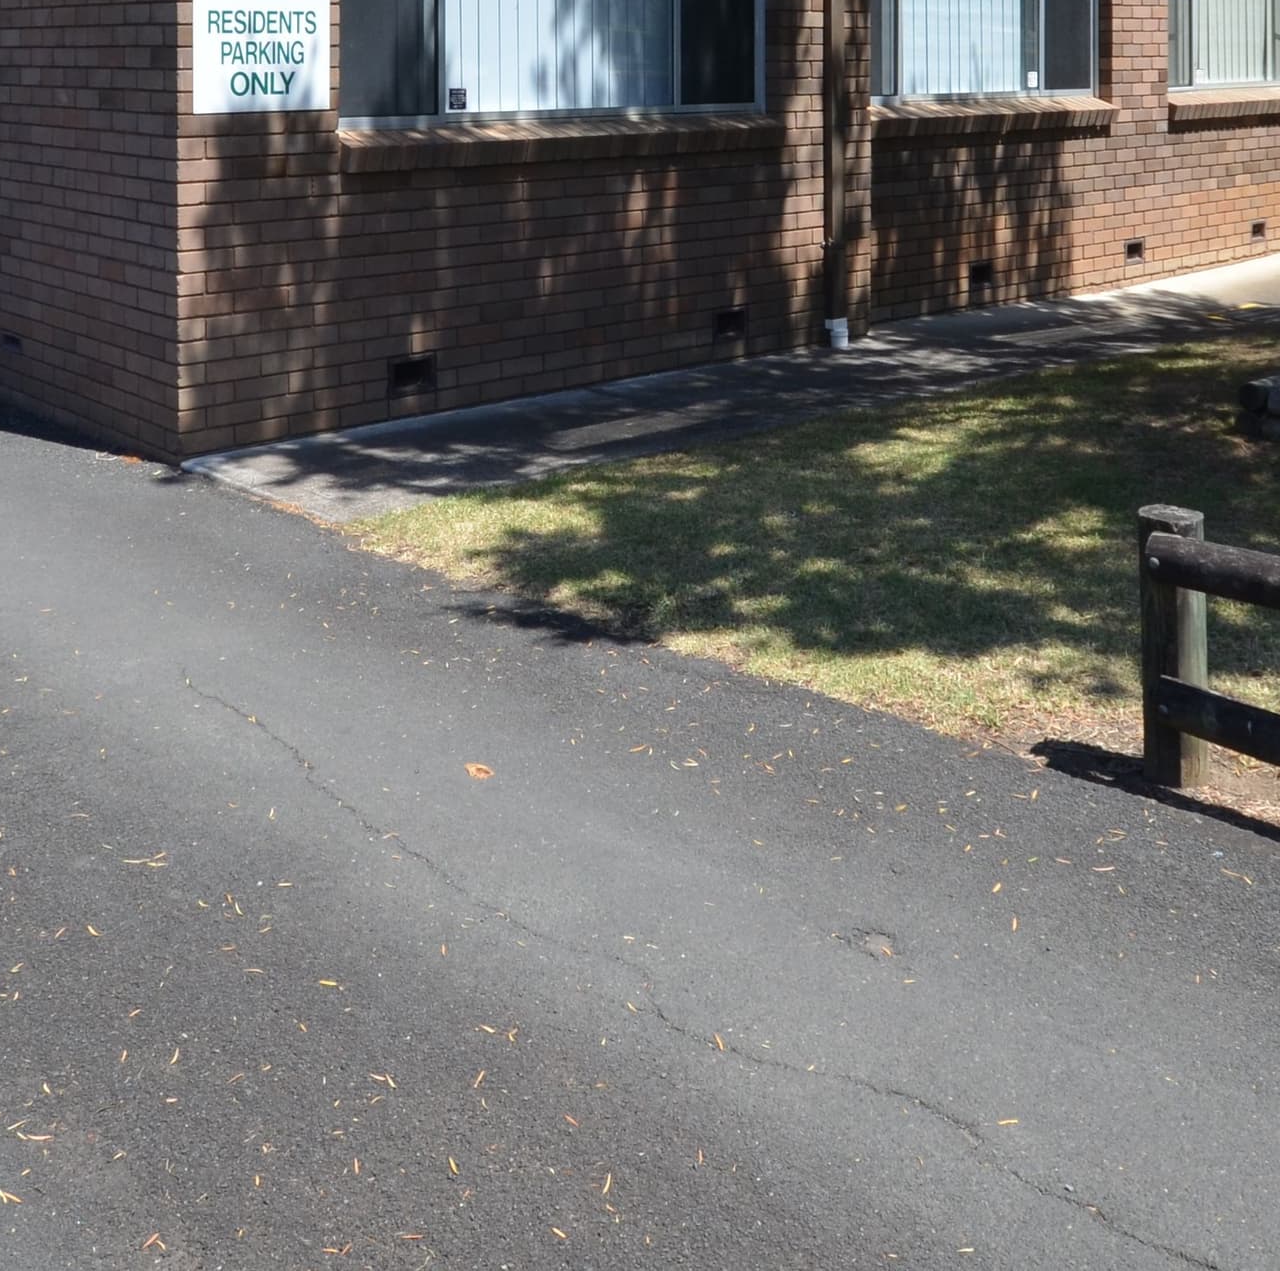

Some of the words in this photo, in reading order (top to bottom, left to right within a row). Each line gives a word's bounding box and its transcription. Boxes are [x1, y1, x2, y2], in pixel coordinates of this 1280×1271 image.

[207, 9, 317, 34] RESIDENTS
[221, 40, 304, 65] PARKING
[230, 71, 295, 97] ONLY
